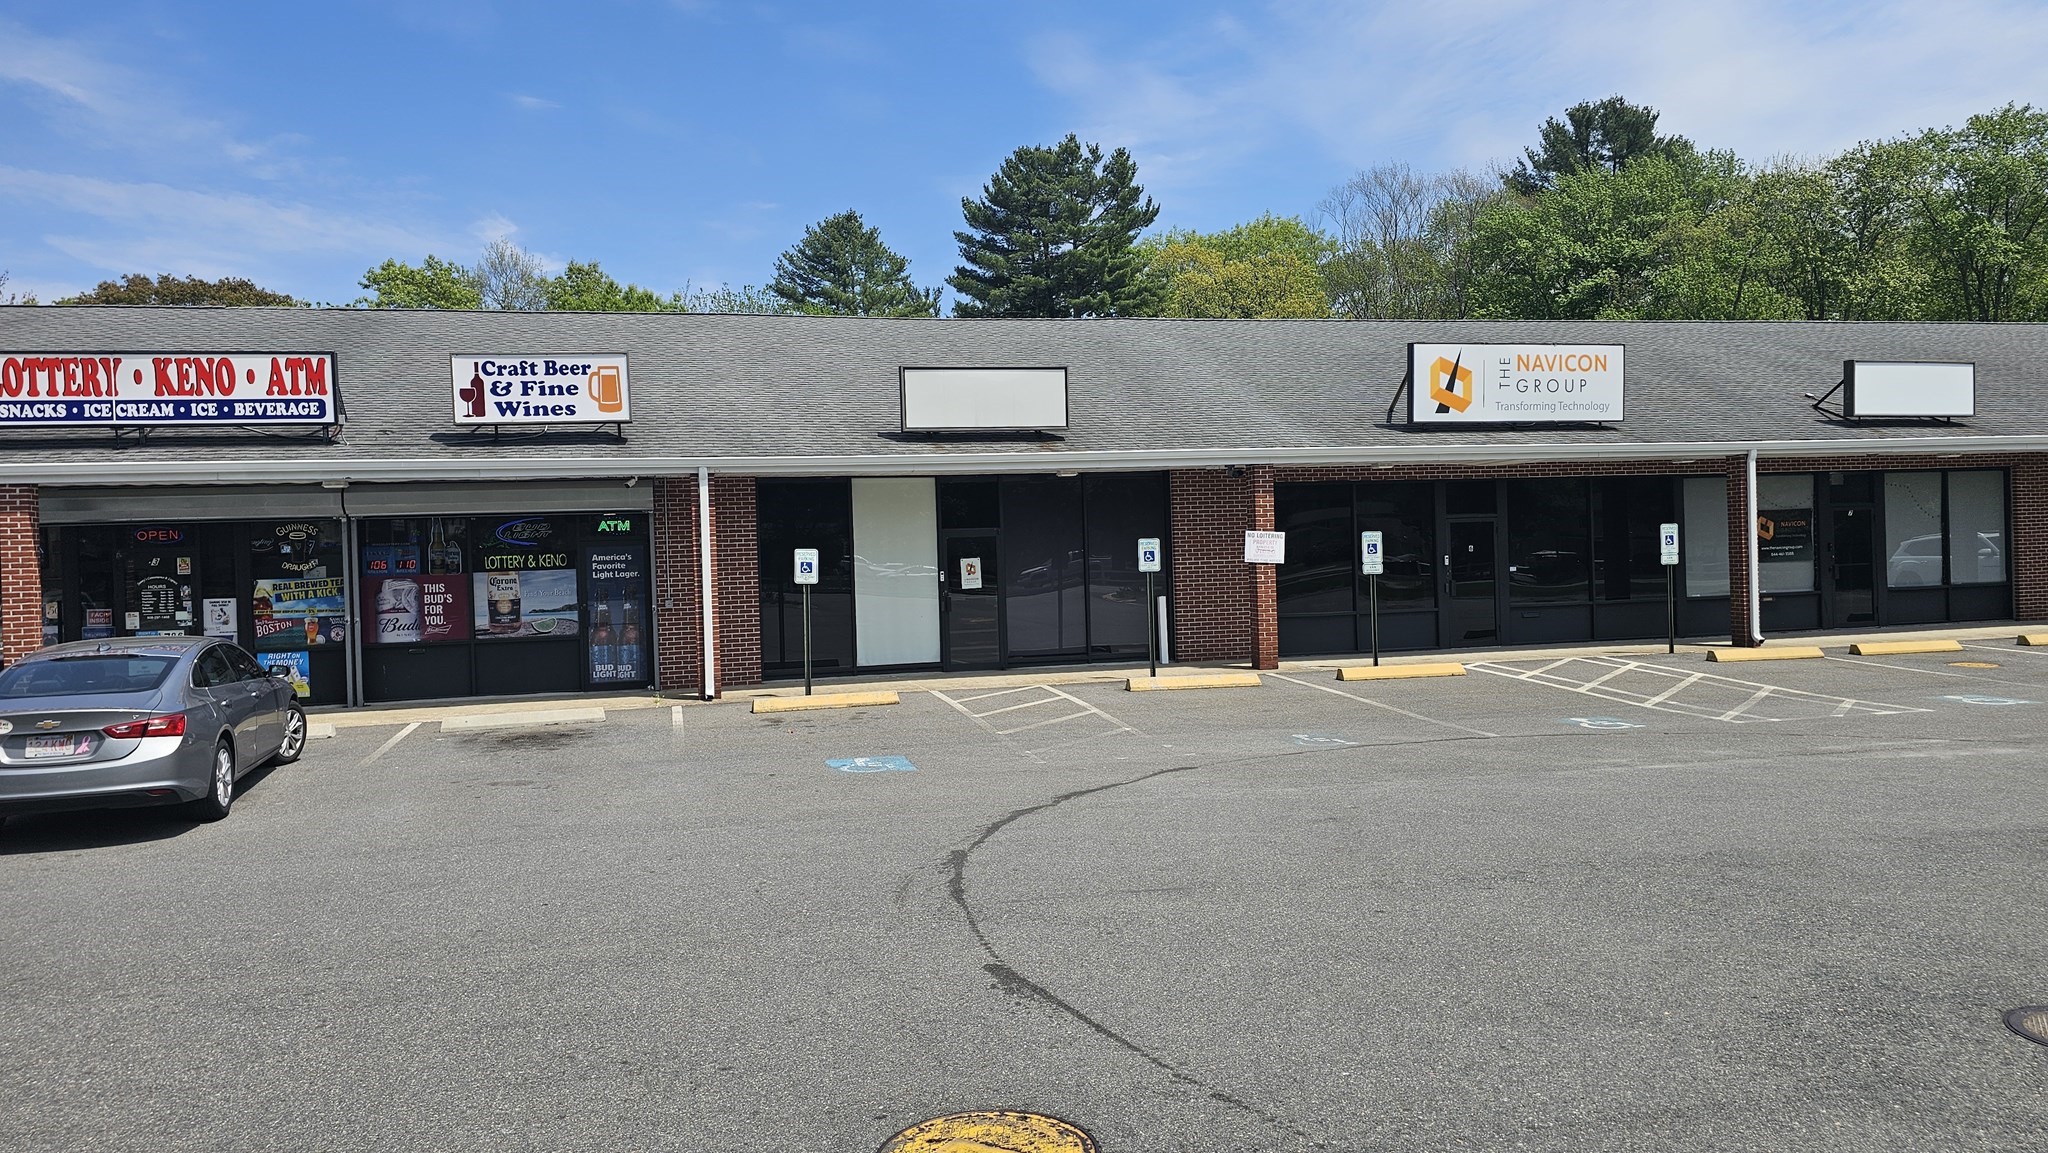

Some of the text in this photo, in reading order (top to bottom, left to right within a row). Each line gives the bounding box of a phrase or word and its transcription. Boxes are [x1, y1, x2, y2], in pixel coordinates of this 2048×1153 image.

[481, 360, 592, 376] Craft Beer
[1517, 354, 1607, 372] NAVICON
[0, 357, 328, 398] OTTERY KENO ATM
[1499, 357, 1511, 390] THE
[490, 380, 578, 396] & Fine
[1516, 378, 1587, 393] GROUP
[0, 402, 320, 418] SNACKS ICE CREAM ICE BEVERAGE
[494, 401, 576, 417] Wines
[1496, 401, 1610, 414] Transforming Technology
[276, 524, 318, 536] GUINNESS
[598, 520, 630, 532] ATM
[136, 530, 178, 540] OPEN
[282, 559, 318, 571] DRAUGHT
[370, 560, 387, 570] 106
[484, 553, 568, 570] LOTTERY & KENO
[592, 562, 626, 570] Favorite
[592, 571, 640, 580] Light Lager.
[272, 583, 293, 591] REAL
[294, 580, 328, 589] BREWED
[423, 583, 445, 593] THIS
[490, 576, 517, 588] Corona
[281, 591, 306, 601] WITH
[425, 605, 443, 614] FOR
[425, 616, 446, 625] YOU.
[256, 620, 292, 637] BOSTON
